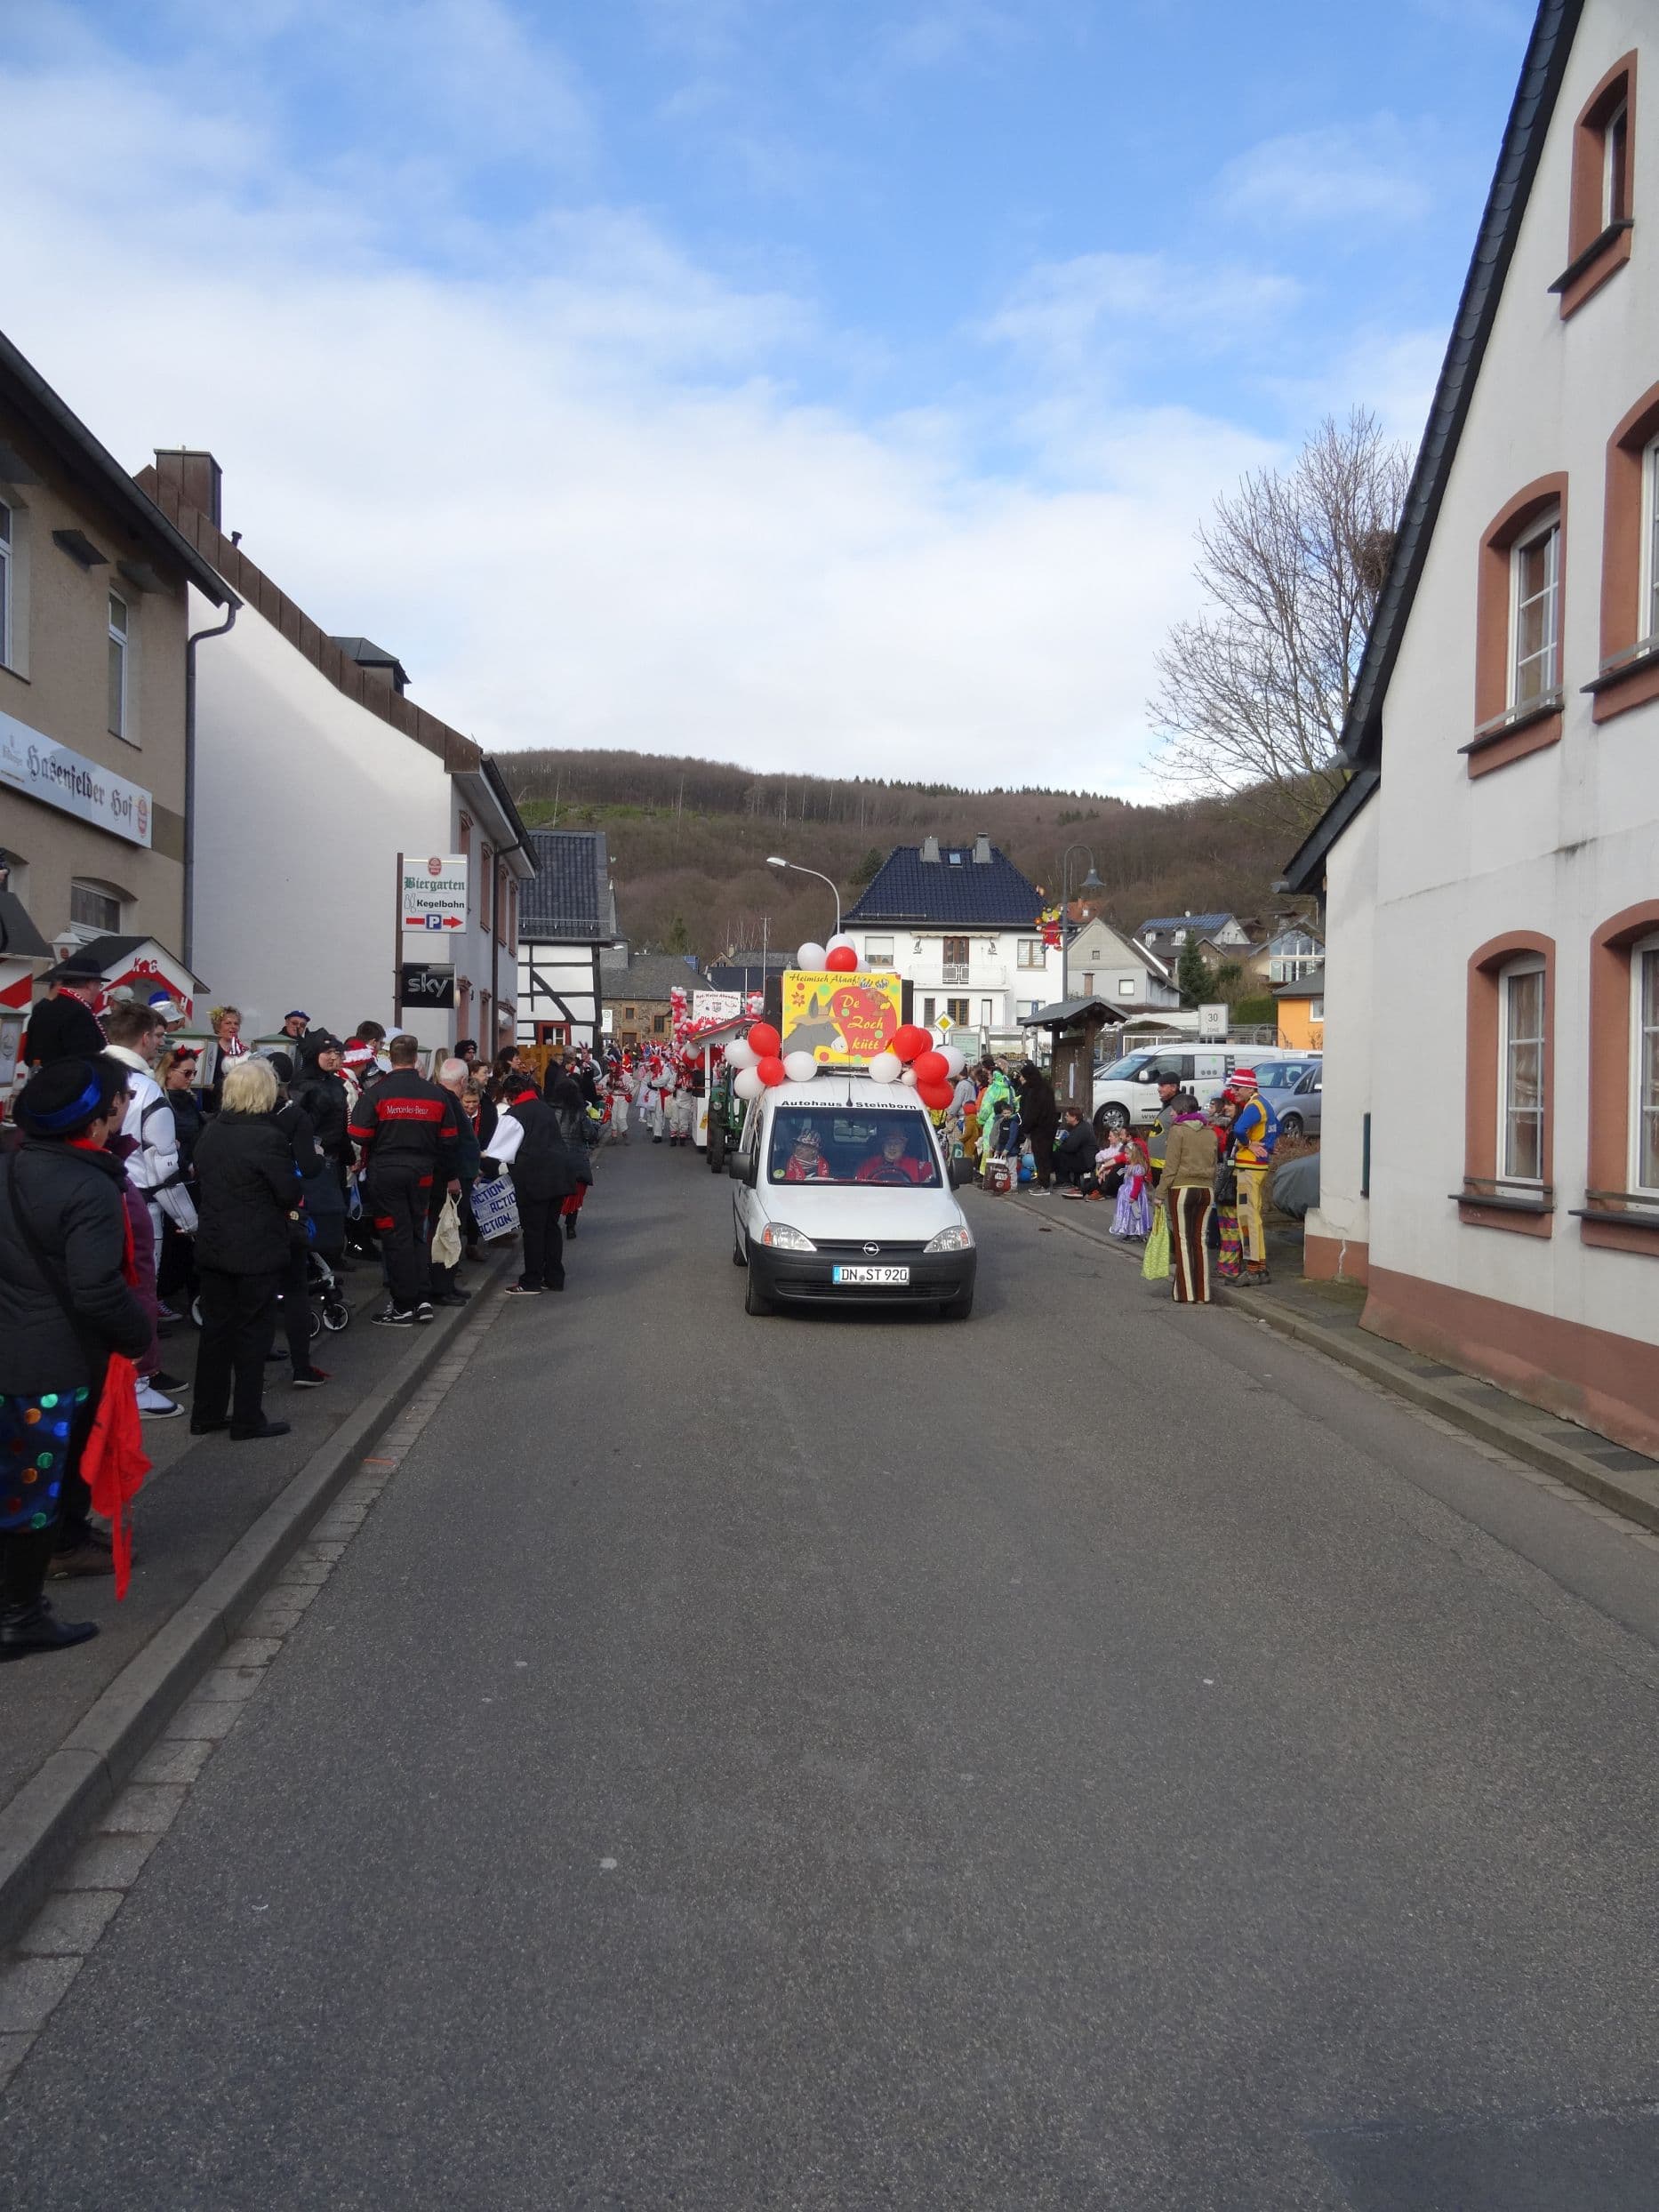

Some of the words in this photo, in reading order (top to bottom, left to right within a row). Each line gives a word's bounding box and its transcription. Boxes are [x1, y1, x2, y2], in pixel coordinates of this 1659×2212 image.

[404, 877, 465, 891] Biergarten
[416, 899, 465, 909] Kegelbahn
[429, 918, 440, 928] P
[407, 974, 448, 998] sky
[840, 994, 861, 1008] De
[847, 1016, 884, 1030] Zoch
[1207, 1013, 1218, 1022] 30
[386, 1105, 429, 1115] Mercedes-Benz
[855, 1102, 917, 1110] Steinborn
[489, 1191, 517, 1214] ACTIO
[841, 1269, 858, 1280] DN
[866, 1269, 882, 1280] ST
[885, 1269, 907, 1280] 920
